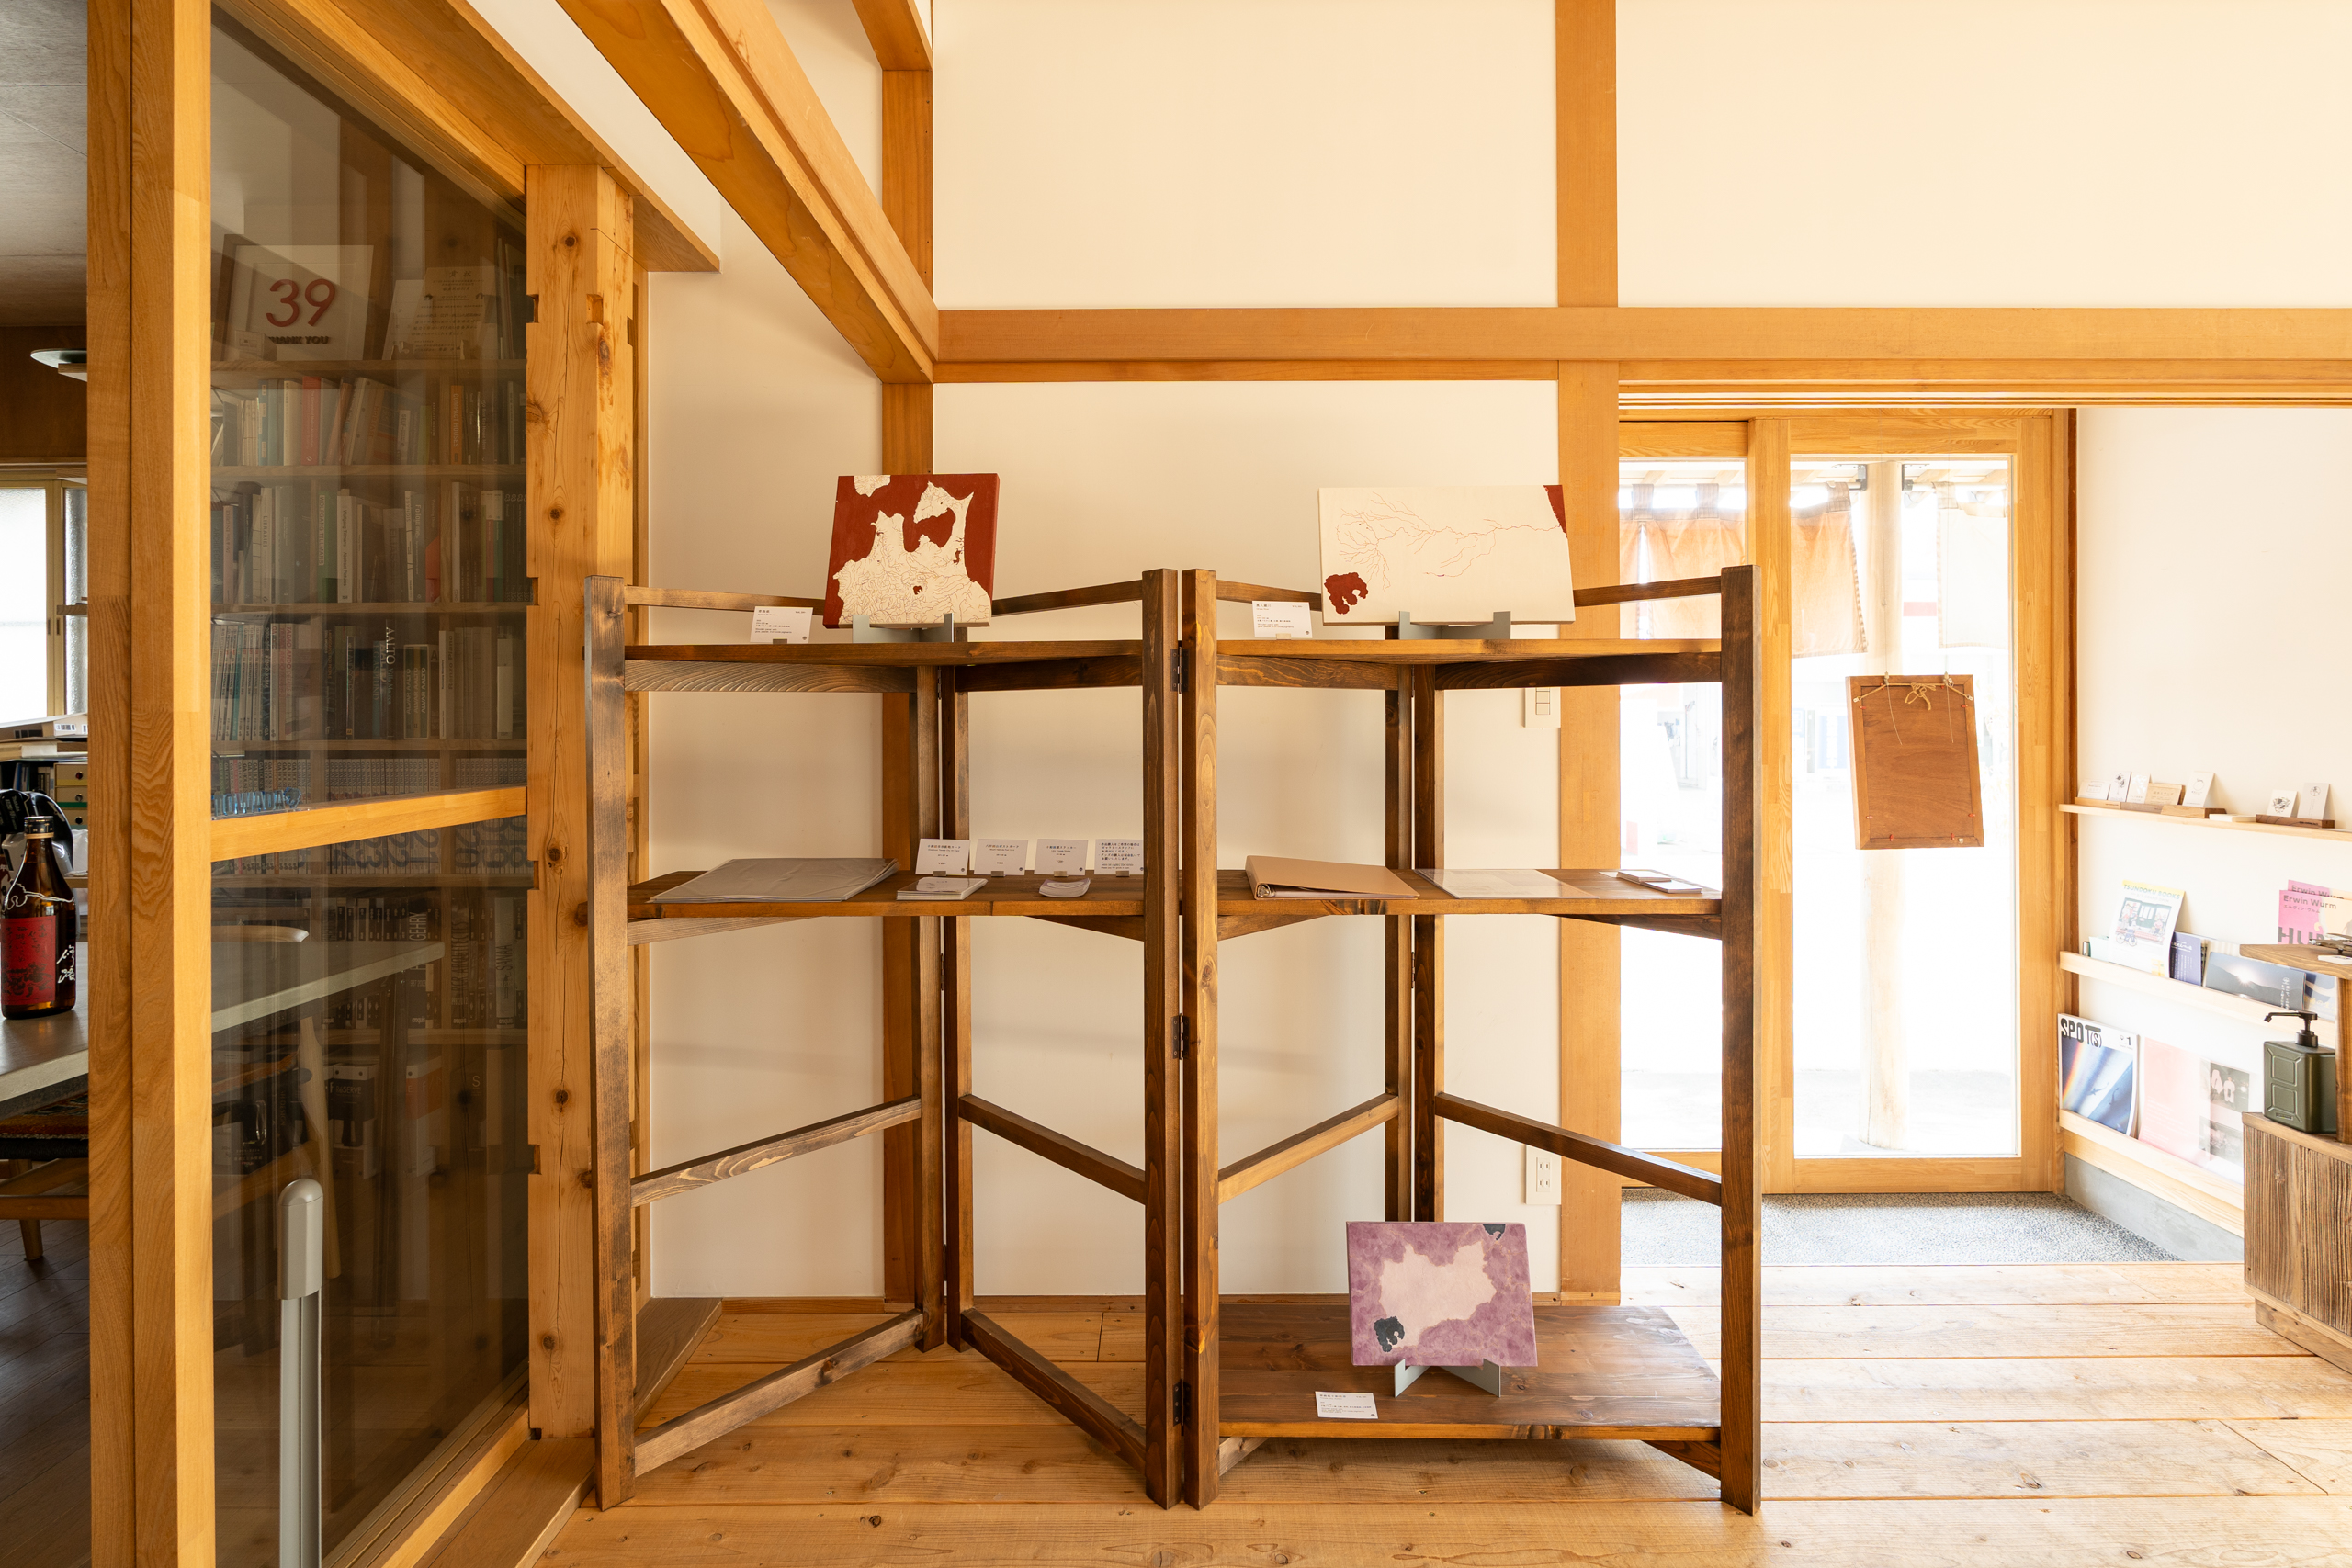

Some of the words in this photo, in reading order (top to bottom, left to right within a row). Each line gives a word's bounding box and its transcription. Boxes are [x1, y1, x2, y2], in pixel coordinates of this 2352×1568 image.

[266, 278, 336, 327] 39
[415, 526, 420, 536] me
[386, 627, 396, 664] AALTO
[2123, 885, 2157, 895] TSUNDOKU
[2158, 891, 2180, 900] BOOKS
[2283, 895, 2308, 905] Erwin
[2311, 898, 2336, 909] Wurm
[2291, 885, 2315, 895] Erwin
[409, 912, 426, 941] GEHRY
[496, 944, 513, 971] SANAA
[2061, 1018, 2102, 1048] SPOT(S)
[2126, 1036, 2131, 1045] 1
